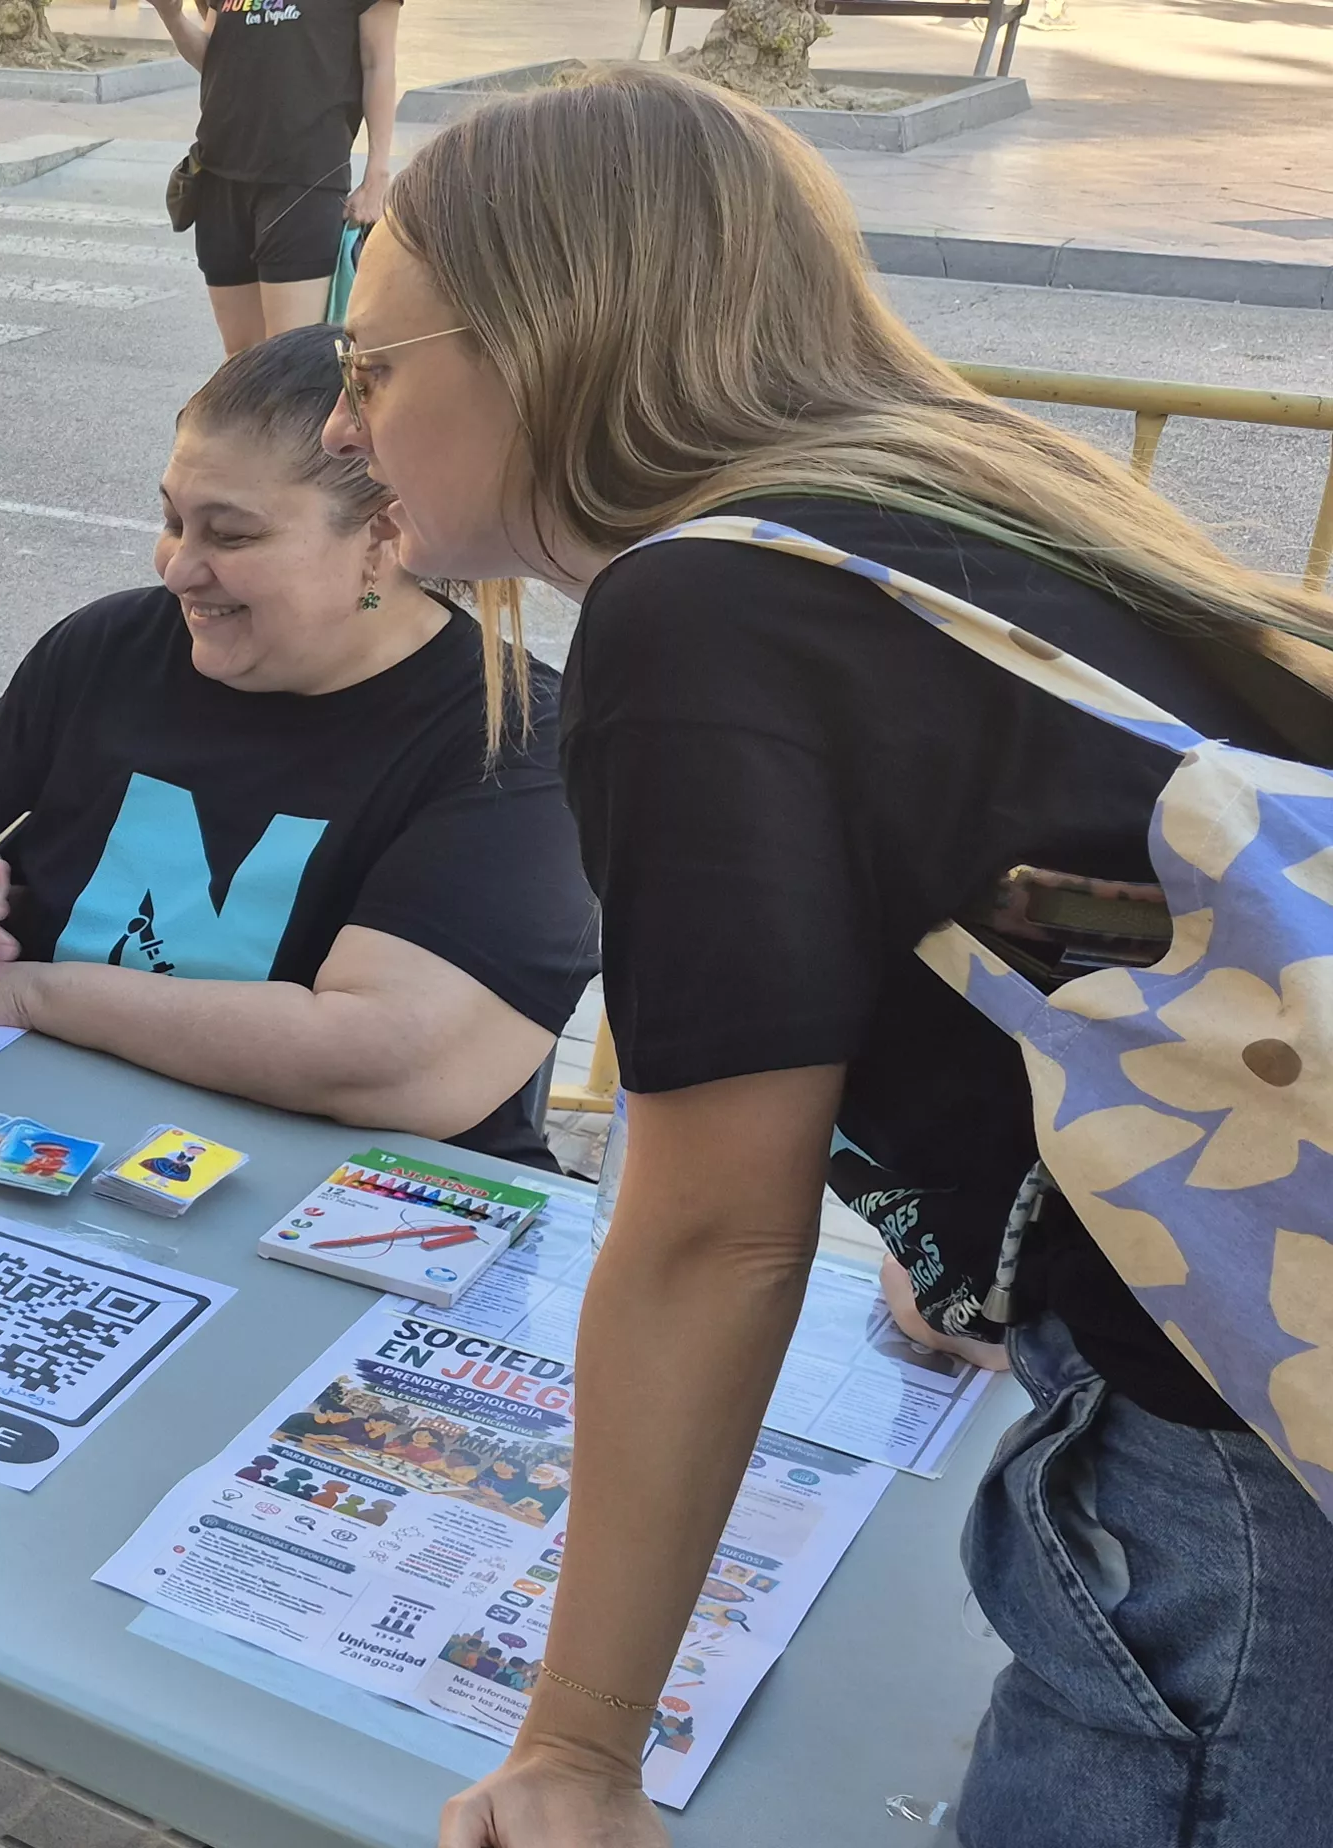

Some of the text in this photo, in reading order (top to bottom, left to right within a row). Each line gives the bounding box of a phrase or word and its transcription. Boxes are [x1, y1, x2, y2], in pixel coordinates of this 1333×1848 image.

[52, 771, 330, 982] N
[379, 1153, 398, 1164] 12
[325, 1185, 346, 1196] 12
[385, 1167, 490, 1199] ALPINO
[375, 1339, 436, 1369] EN
[373, 1365, 543, 1421] APRENDER SOCIOLOGÍA
[397, 1382, 444, 1401] través
[447, 1397, 471, 1409] del
[441, 1360, 575, 1416] JUEG
[374, 1386, 534, 1436] UNA EXPERIENCIA PARTICIPATIVA
[281, 1448, 396, 1493] PARA TODAS LAS EDADES
[225, 1522, 289, 1552] INVESTIGADORAS
[289, 1545, 347, 1572] RESPONSABLES
[719, 1546, 765, 1566] JUEGOS!
[336, 1630, 427, 1669] Universidad
[338, 1645, 406, 1675] Zaragoza
[445, 1684, 477, 1703] sobre
[451, 1673, 476, 1690] Más
